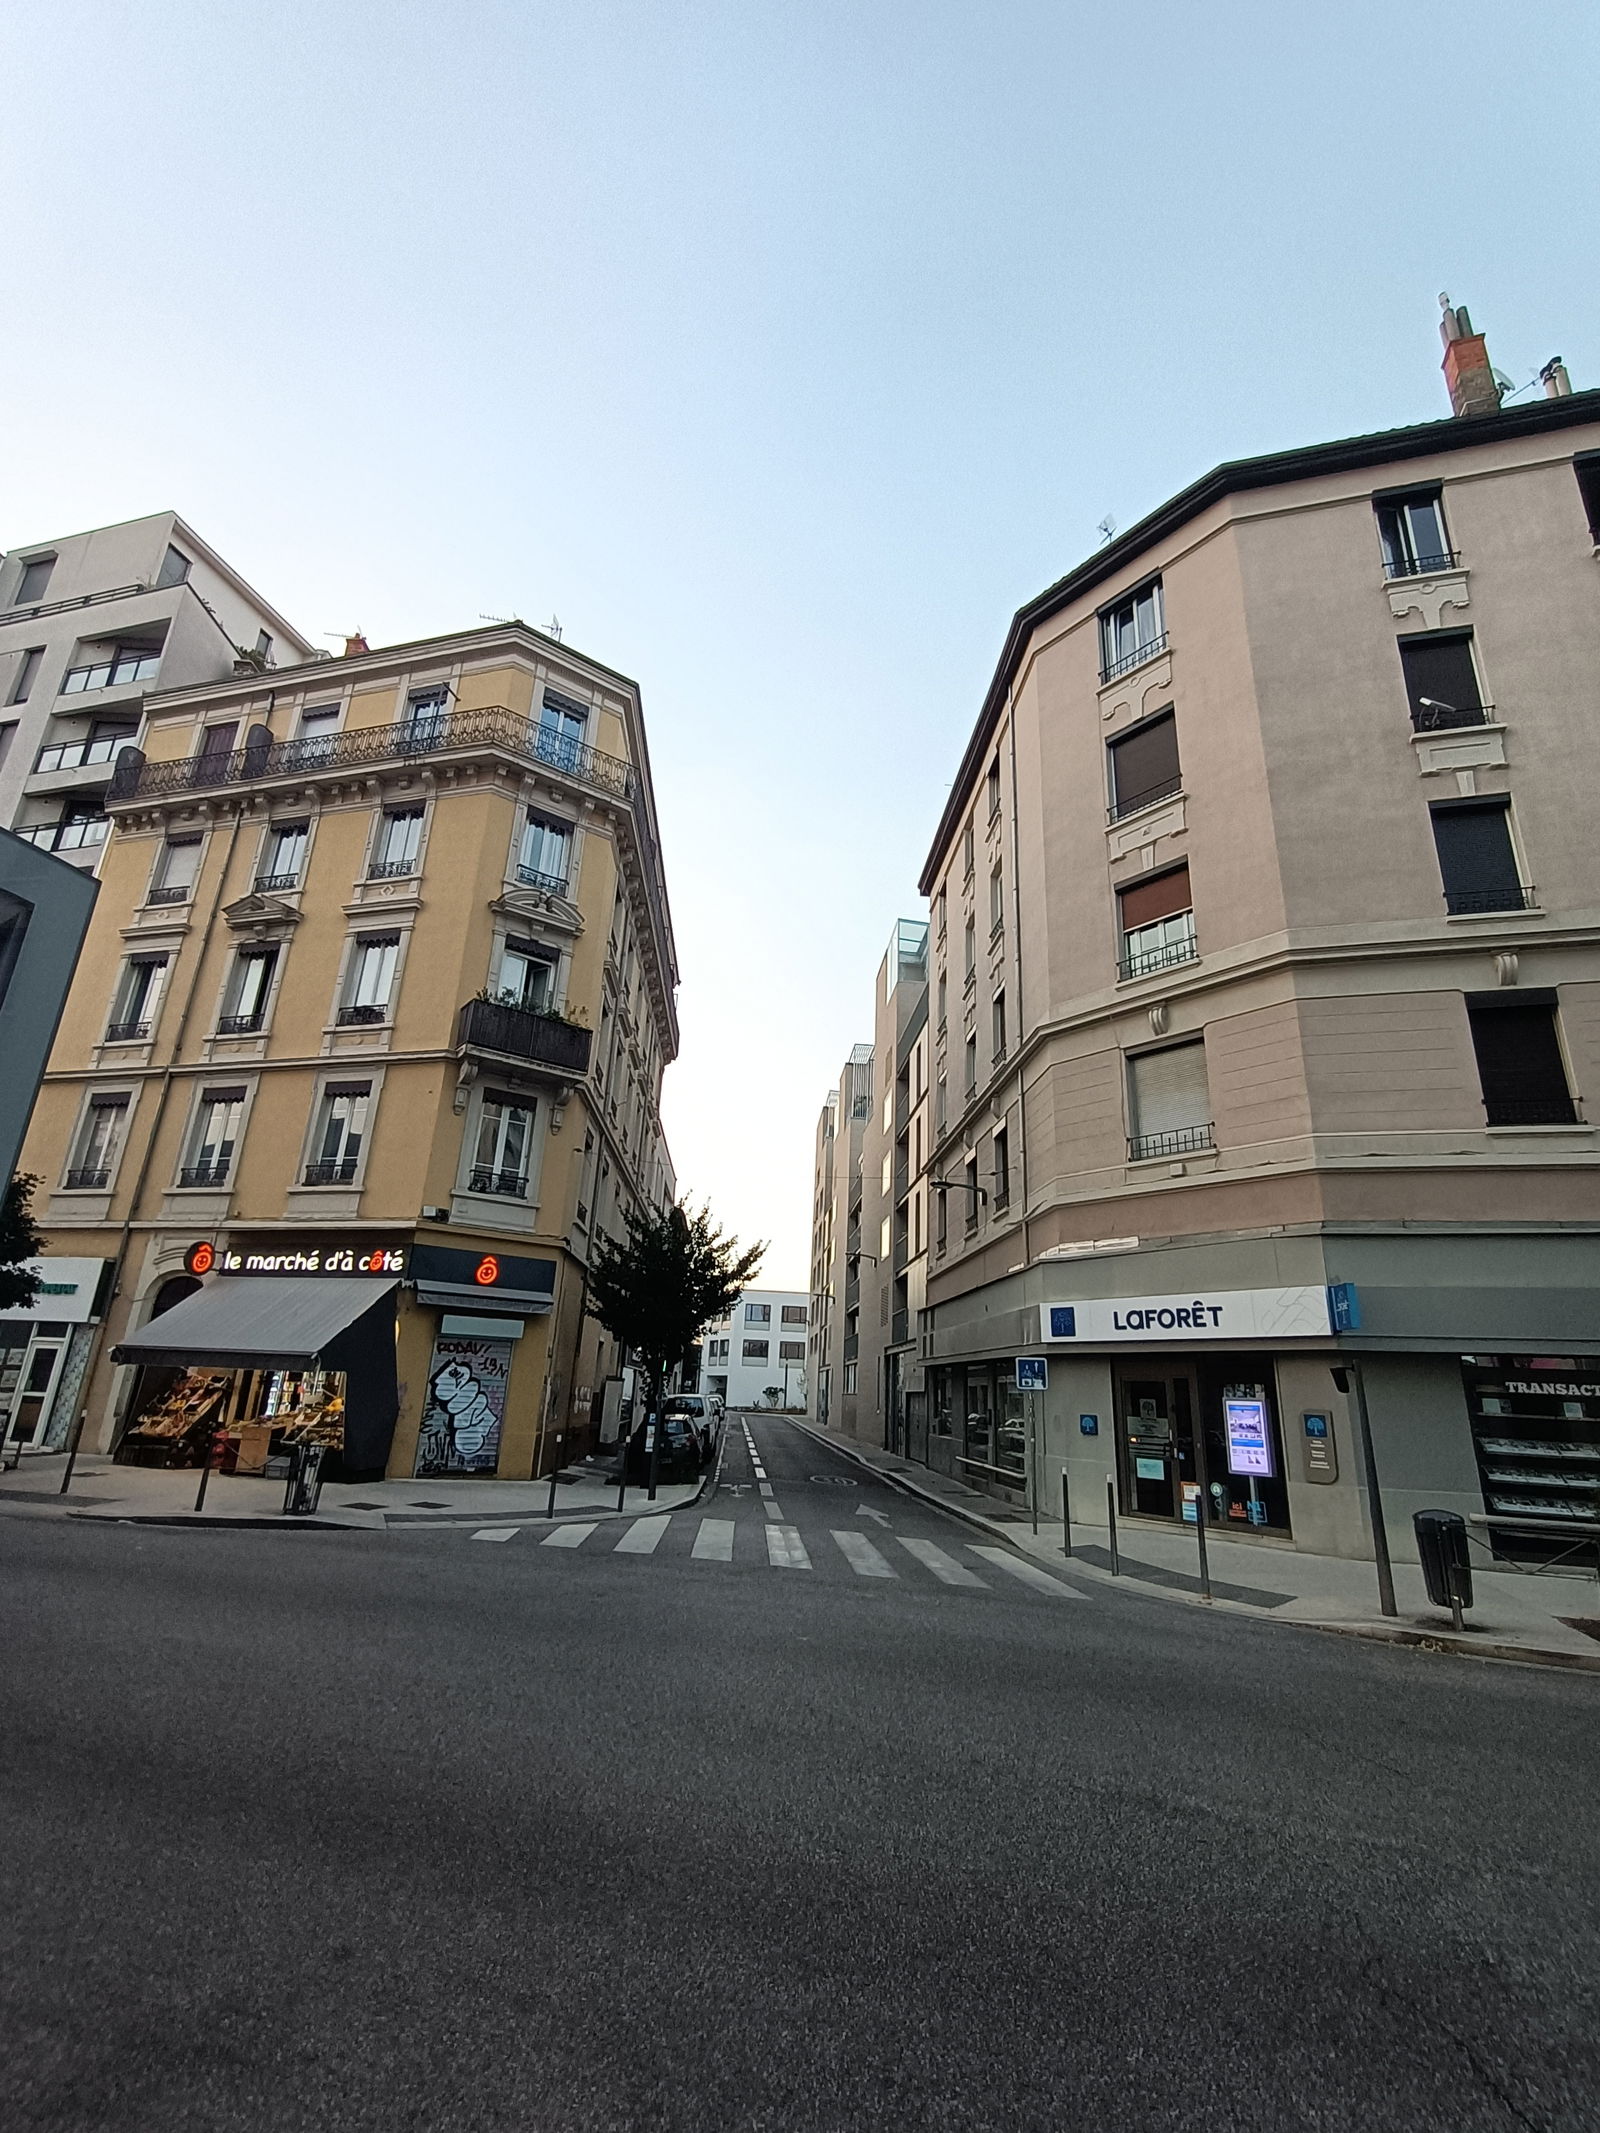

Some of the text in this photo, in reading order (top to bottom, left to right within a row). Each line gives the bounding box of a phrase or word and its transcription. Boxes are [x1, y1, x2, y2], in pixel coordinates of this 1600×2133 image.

[223, 1249, 404, 1272] le marché d'à côté
